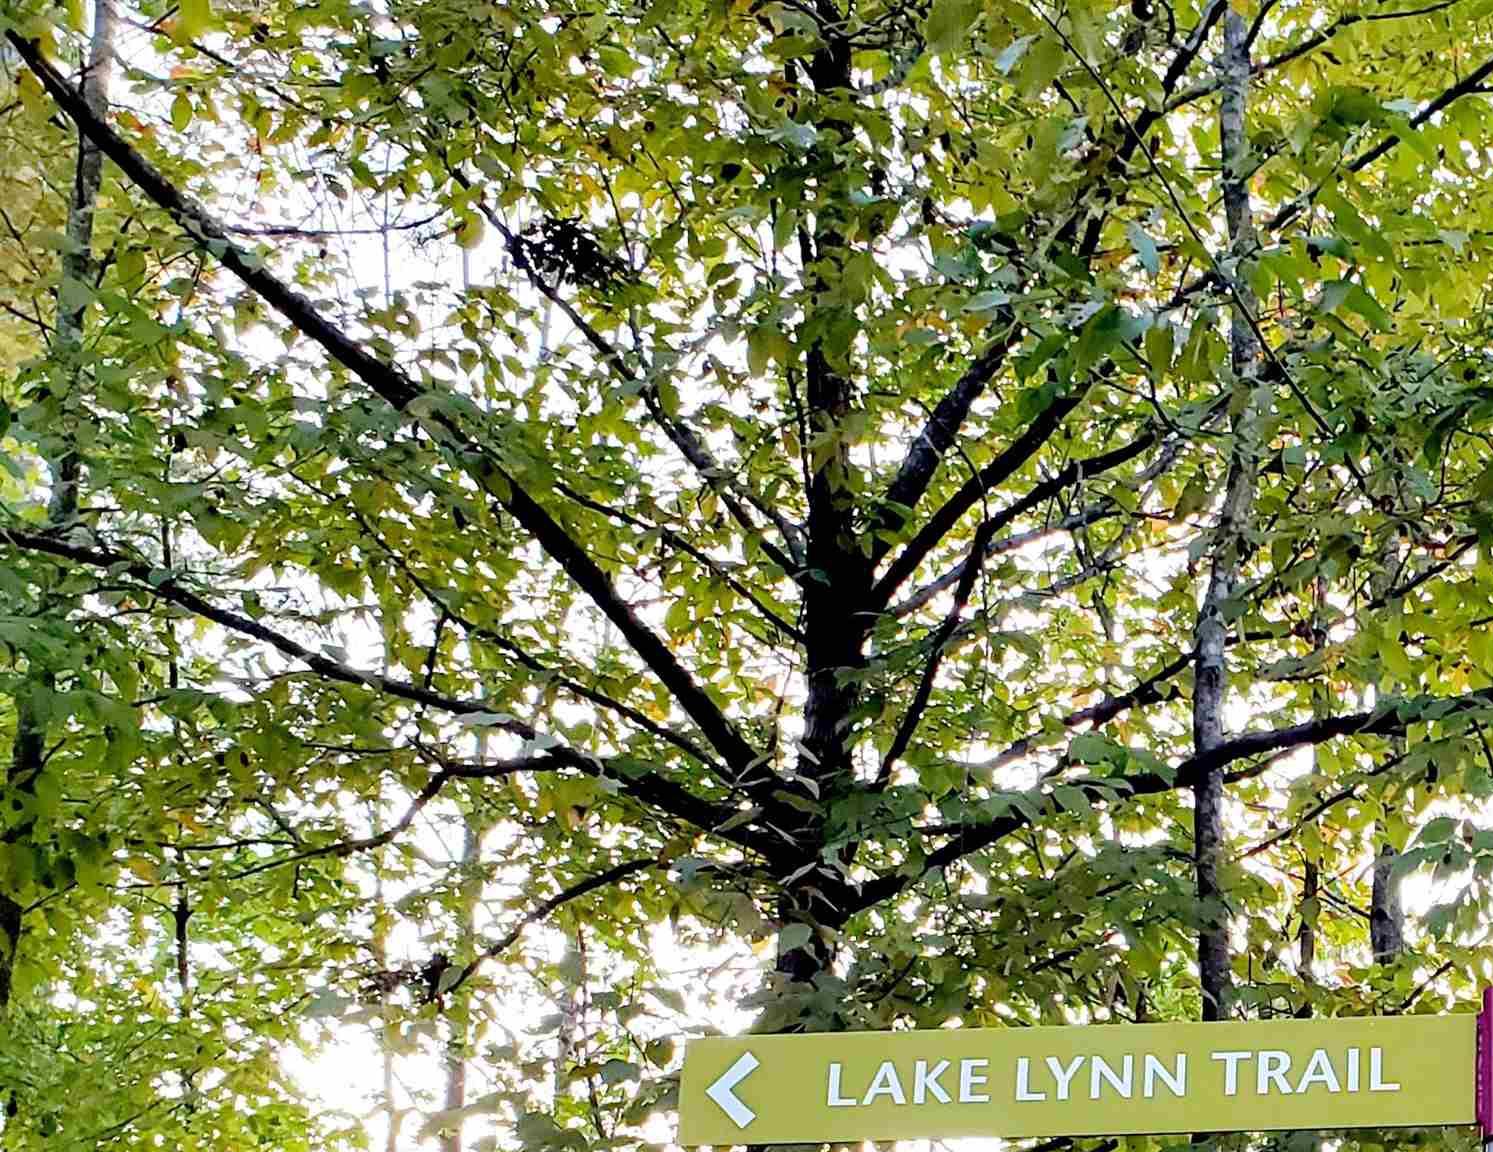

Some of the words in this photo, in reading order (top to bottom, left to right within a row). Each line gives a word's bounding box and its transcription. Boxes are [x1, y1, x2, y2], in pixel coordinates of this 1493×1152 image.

[827, 1057, 990, 1107] LAKE
[1014, 1052, 1187, 1101] LYNN
[1210, 1047, 1400, 1096] TRAIL
